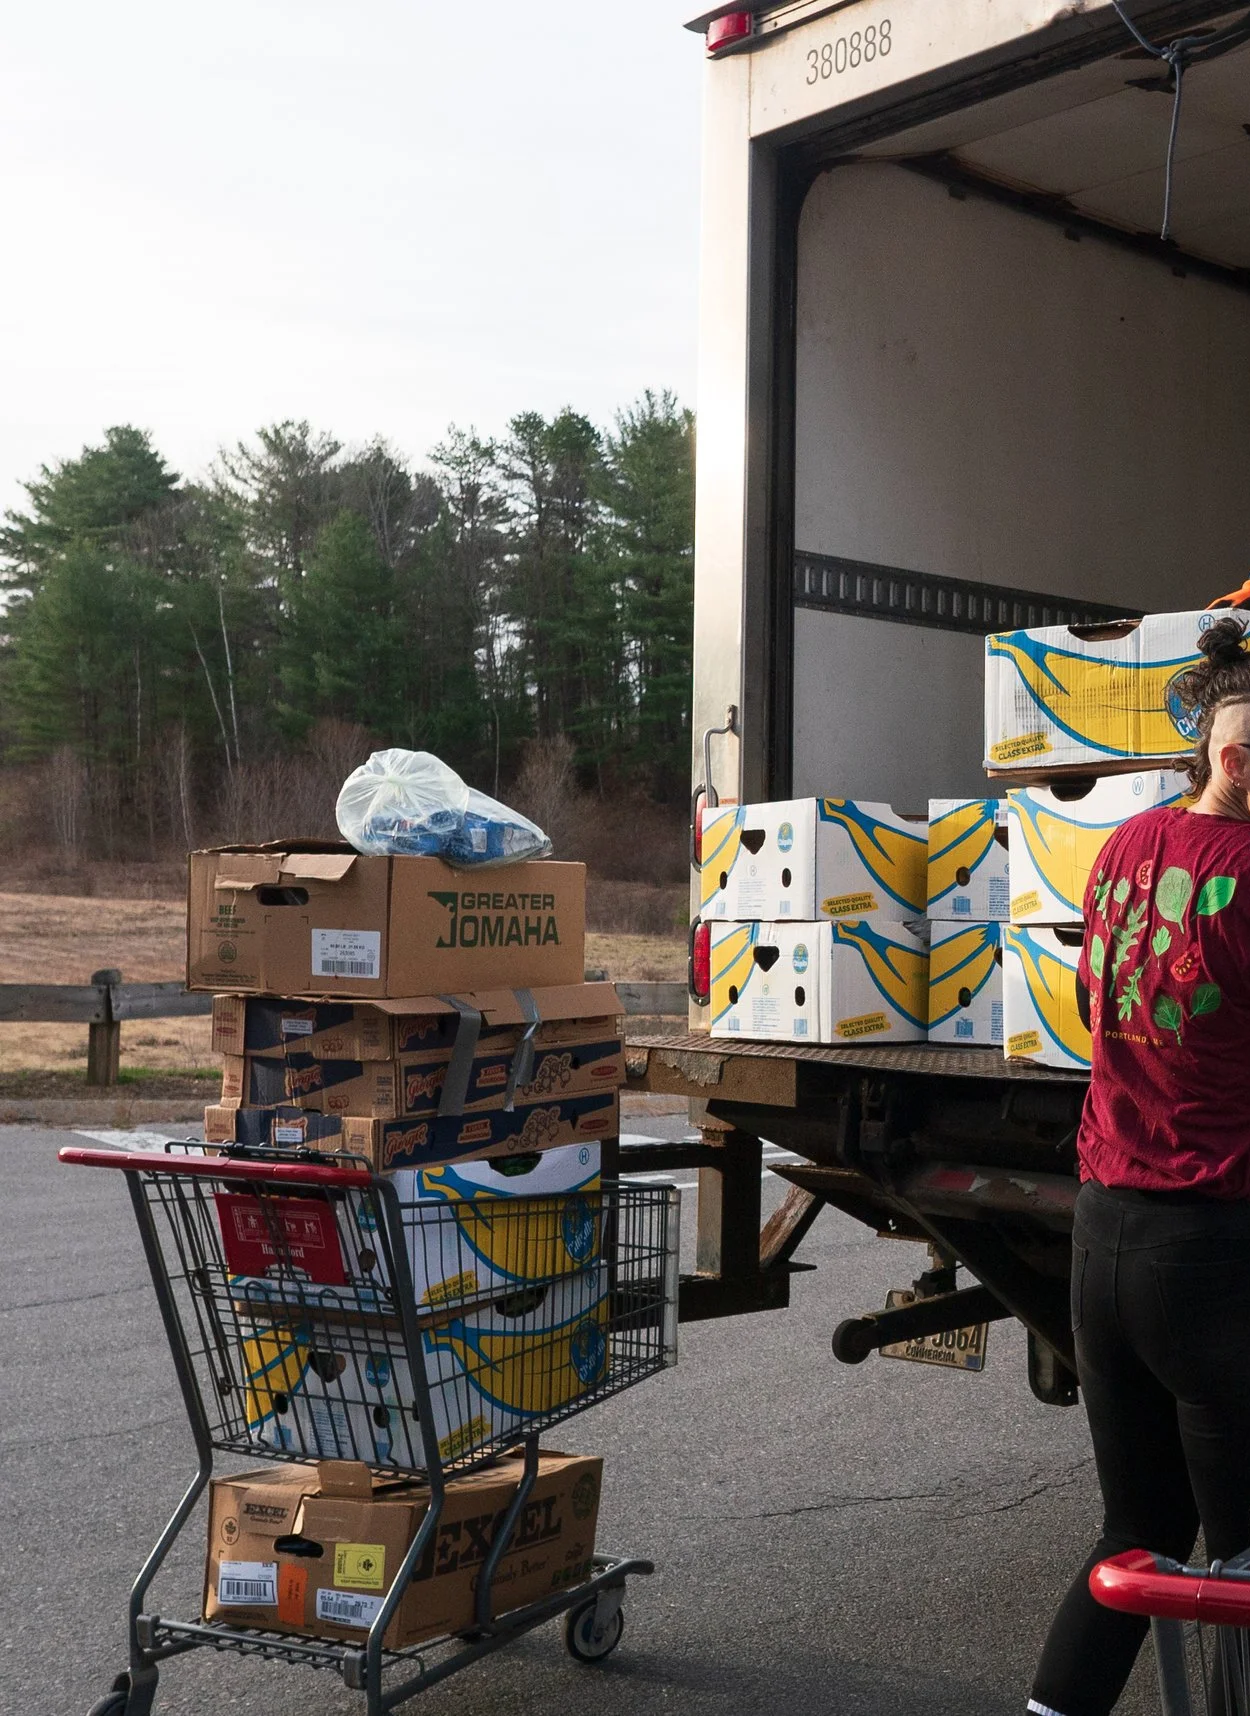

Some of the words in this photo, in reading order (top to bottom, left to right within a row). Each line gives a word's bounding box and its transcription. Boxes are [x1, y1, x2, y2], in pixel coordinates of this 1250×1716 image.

[806, 19, 892, 85] 380888
[995, 739, 1020, 753] SELECTED
[998, 749, 1021, 760] CLASS
[1021, 742, 1046, 756] EXTRA
[461, 892, 556, 911] GREATER
[830, 904, 850, 915] CLASS
[850, 901, 872, 912] EXTRA
[1025, 899, 1039, 911] EXTRA
[459, 914, 560, 948] OMAHA
[843, 1027, 863, 1038] CLASS
[863, 1023, 885, 1034] EXTRA
[1105, 1030, 1149, 1045] PORTLAND,
[1010, 1041, 1024, 1052] CLASS
[1024, 1039, 1038, 1049] EXTRA
